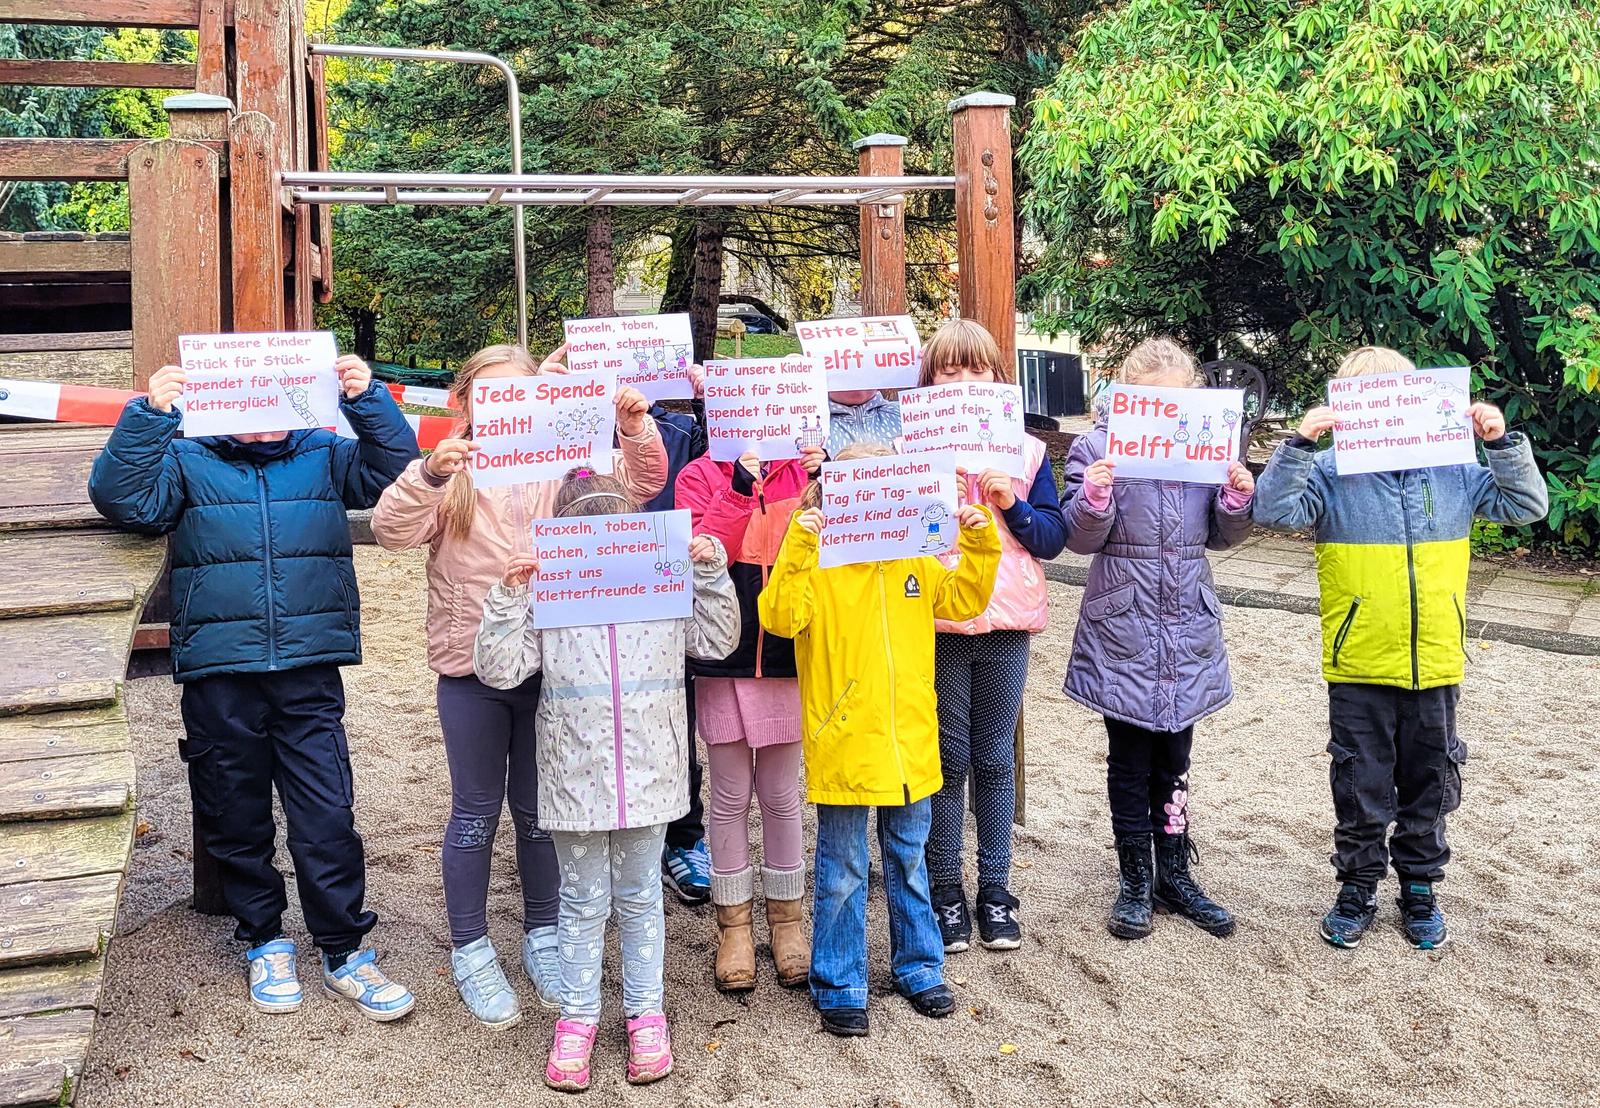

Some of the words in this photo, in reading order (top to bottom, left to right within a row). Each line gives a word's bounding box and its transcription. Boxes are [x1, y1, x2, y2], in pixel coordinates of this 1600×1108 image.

[567, 322, 616, 335] Kraxeln,
[621, 320, 658, 331] toben,
[800, 326, 858, 340] Bitte
[182, 339, 207, 350] Für
[214, 338, 261, 349] unsere
[267, 336, 311, 348] Kinder
[616, 337, 670, 349] schreien-
[185, 357, 228, 371] Stück
[234, 356, 256, 368] für
[264, 354, 311, 366] Stück-
[570, 360, 598, 371] lasst
[604, 359, 622, 368] uns
[806, 349, 864, 370] elft
[874, 345, 915, 367] uns!
[663, 369, 688, 379] sein!
[706, 365, 728, 377] Für
[735, 365, 776, 376] unsere
[780, 362, 812, 374] Kinder
[186, 377, 243, 394] spendet
[250, 376, 272, 388] für
[279, 374, 317, 386] unser
[475, 384, 526, 404] Jede
[535, 380, 606, 405] Spende
[707, 385, 745, 398] Stück
[751, 384, 771, 396] für
[776, 382, 812, 394] Stück-
[1331, 382, 1353, 394] Mit
[1358, 378, 1397, 394] jedem
[1403, 374, 1437, 386] Euro,
[186, 395, 279, 412] Kletterglück!
[901, 393, 921, 405] Mit
[926, 387, 963, 404] jedem
[968, 385, 998, 398] Euro,
[1332, 400, 1362, 412] klein
[1368, 397, 1390, 409] und
[1396, 394, 1428, 406] fein-
[708, 405, 759, 421] spendet
[765, 404, 785, 416] für
[790, 403, 817, 415] unser
[902, 410, 930, 423] klein
[935, 404, 955, 417] und
[961, 403, 990, 415] fein-
[1113, 392, 1178, 418] Bitte
[476, 416, 532, 437] zählt!
[710, 424, 791, 441] Kletterglück!
[904, 425, 945, 442] wächst
[950, 423, 968, 433] ein
[1334, 418, 1380, 432] wächst
[1386, 416, 1404, 427] ein
[1109, 432, 1175, 459] helft
[1186, 437, 1232, 461] uns!
[1337, 434, 1421, 452] Klettertraum
[1426, 429, 1470, 443] herbei!
[476, 441, 592, 470] Dankeschön!
[824, 471, 846, 484] Für
[853, 461, 930, 481] Kinderlachen
[825, 493, 849, 508] Tag
[855, 490, 875, 503] für
[881, 487, 912, 501] Tag-
[918, 481, 940, 495] weil
[823, 513, 858, 529] jedes
[864, 508, 892, 522] Kind
[897, 506, 919, 518] das
[535, 521, 597, 538] Kraxeln,
[605, 519, 651, 533] toben,
[821, 531, 874, 547] Klettern
[880, 526, 909, 542] mag!
[536, 545, 588, 560] lachen,
[596, 540, 665, 556] schreien-
[536, 569, 572, 582] lasst
[579, 568, 603, 579] uns
[536, 583, 646, 603] Kletterfreunde
[653, 580, 685, 593] sein!
